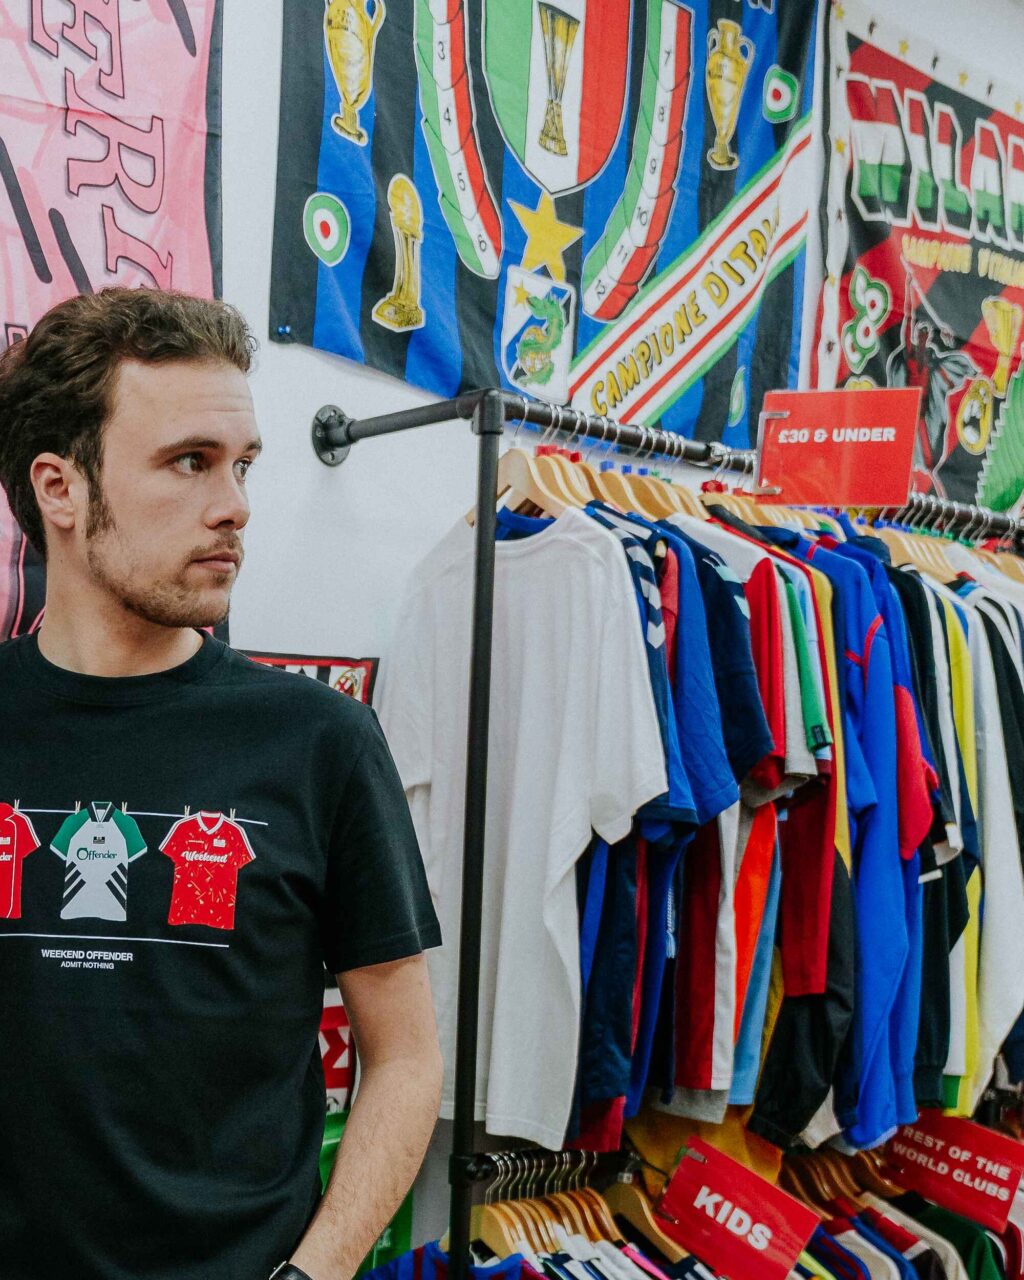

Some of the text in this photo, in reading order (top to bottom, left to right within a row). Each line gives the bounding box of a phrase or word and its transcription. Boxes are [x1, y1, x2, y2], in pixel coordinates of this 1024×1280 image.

[437, 41, 445, 60] 3
[662, 51, 672, 65] 7
[443, 107, 451, 126] 4
[658, 105, 666, 123] 8
[649, 158, 657, 174] 9
[457, 172, 465, 191] 5
[477, 234, 487, 252] 6
[591, 291, 707, 417] CAMPIONE
[778, 427, 896, 443] £30 & UNDER
[77, 847, 117, 861] Offender
[181, 850, 228, 863] Weekend
[41, 949, 134, 961] WEEKEND OFFENDER
[902, 1126, 1012, 1182] REST OF THE
[893, 1142, 1010, 1202] WORLD CLUBS
[693, 1185, 775, 1251] KIDS
